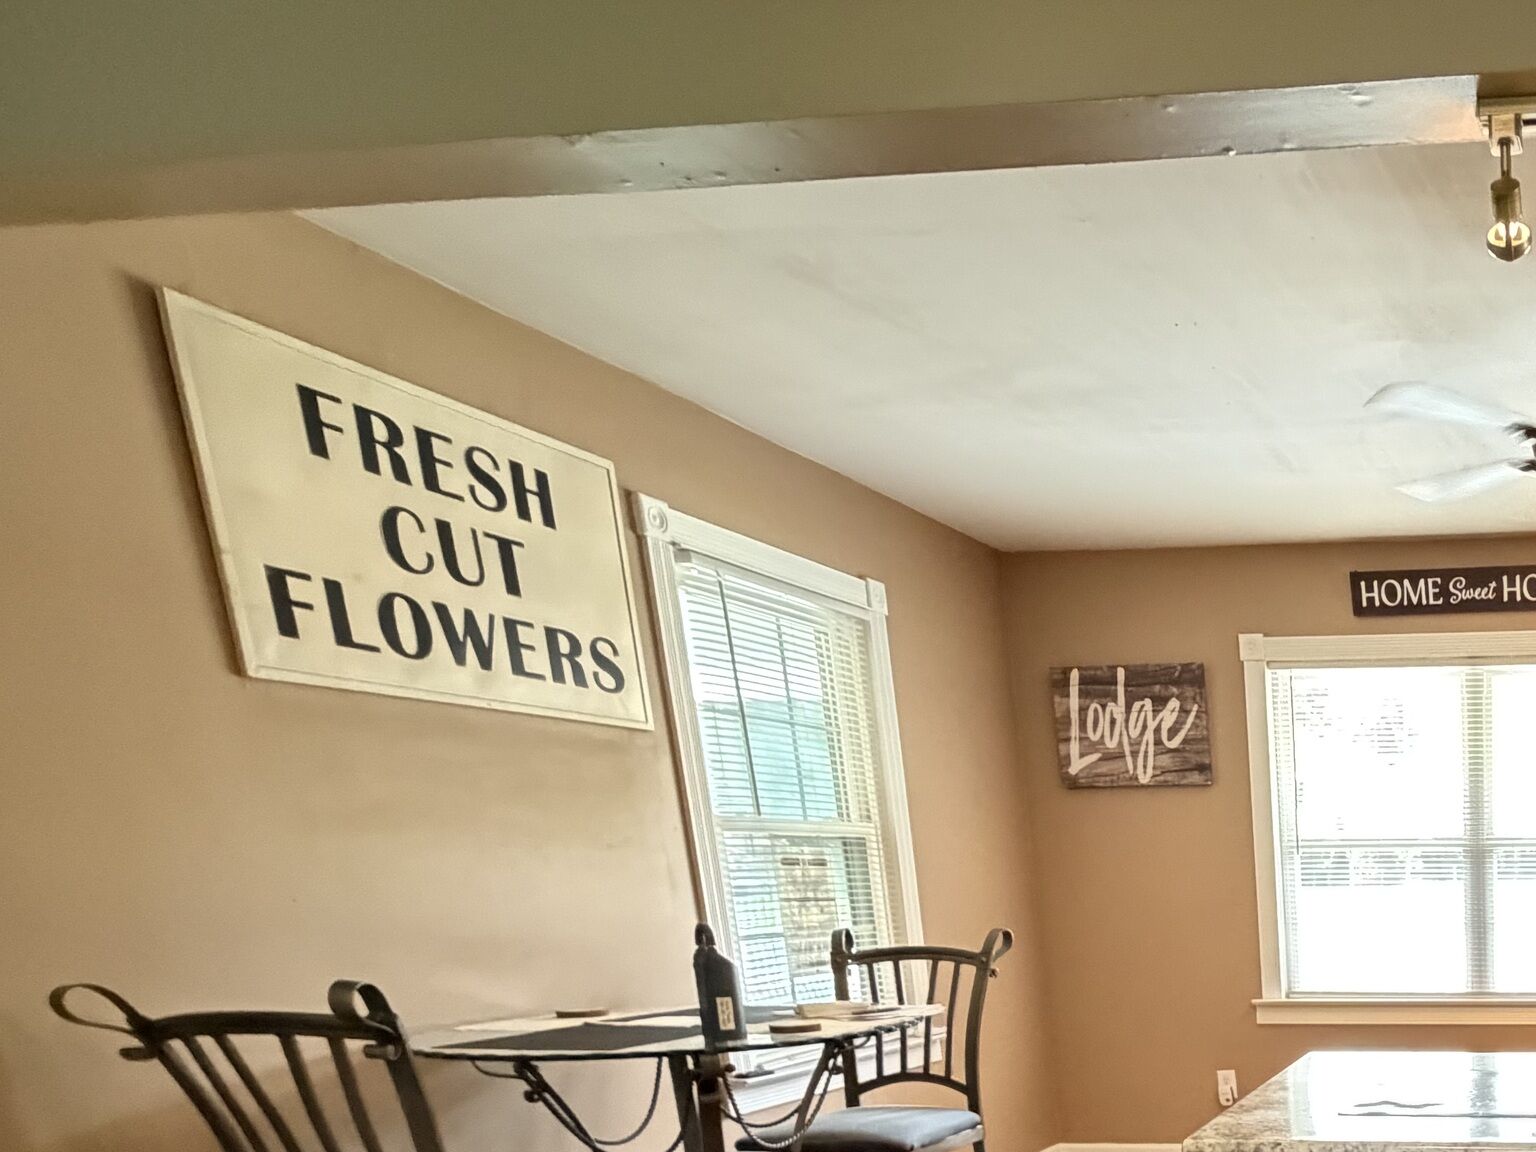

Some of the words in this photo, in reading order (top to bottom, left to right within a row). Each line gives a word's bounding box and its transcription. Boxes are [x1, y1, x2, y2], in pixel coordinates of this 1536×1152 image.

[295, 382, 558, 531] FRESH
[379, 505, 525, 599] CUT
[1359, 577, 1444, 607] HOME
[1448, 576, 1498, 605] Sweet
[263, 563, 627, 695] FLOWERS
[1067, 666, 1199, 784] Lodge
